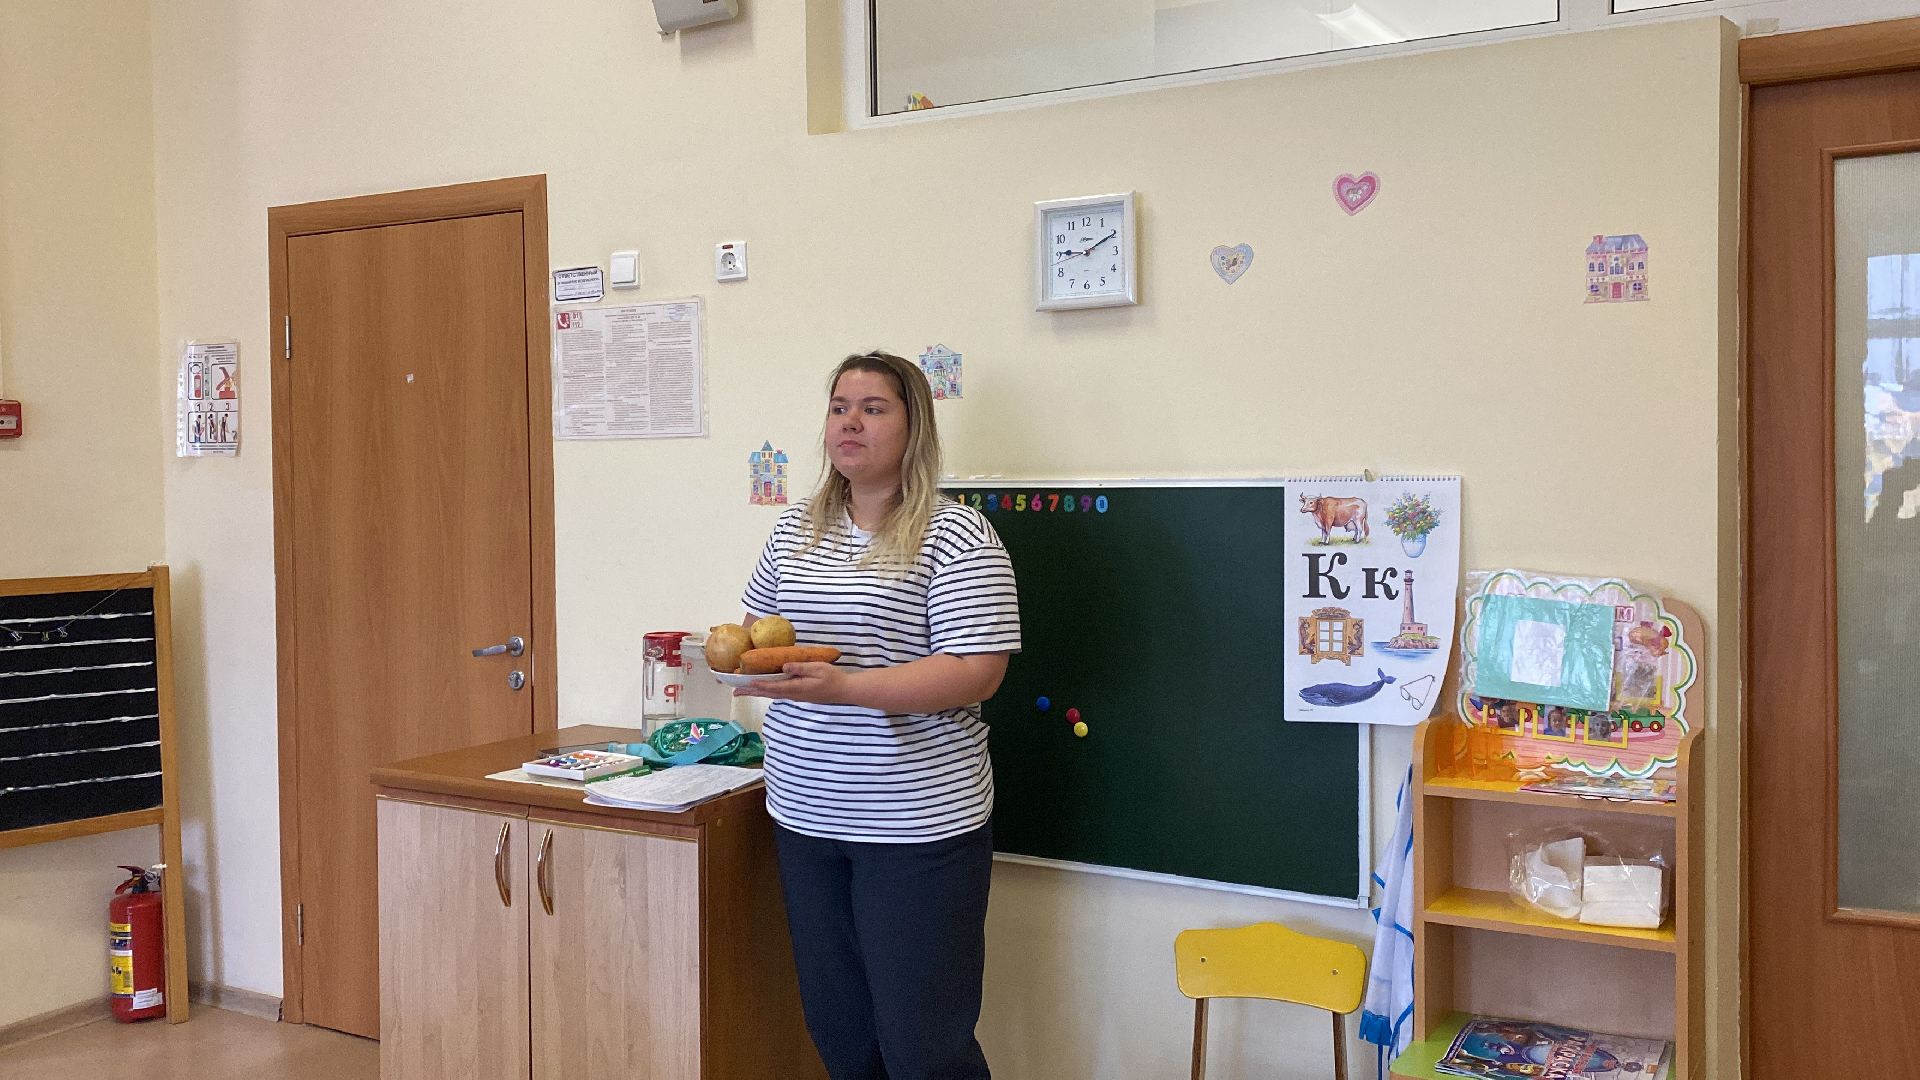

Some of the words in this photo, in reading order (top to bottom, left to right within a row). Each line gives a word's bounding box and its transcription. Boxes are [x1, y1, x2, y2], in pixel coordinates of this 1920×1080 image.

[1067, 221, 1075, 230] 11
[1082, 217, 1091, 226] 12
[1100, 217, 1104, 227] 1
[1056, 234, 1065, 244] 10
[1113, 246, 1118, 255] 3
[1058, 268, 1064, 277] 8
[1111, 264, 1116, 272] 4
[1069, 279, 1075, 288] 7
[1084, 280, 1090, 289] 6
[1100, 277, 1105, 286] 5
[1302, 552, 1350, 600] К
[1361, 566, 1399, 600] к
